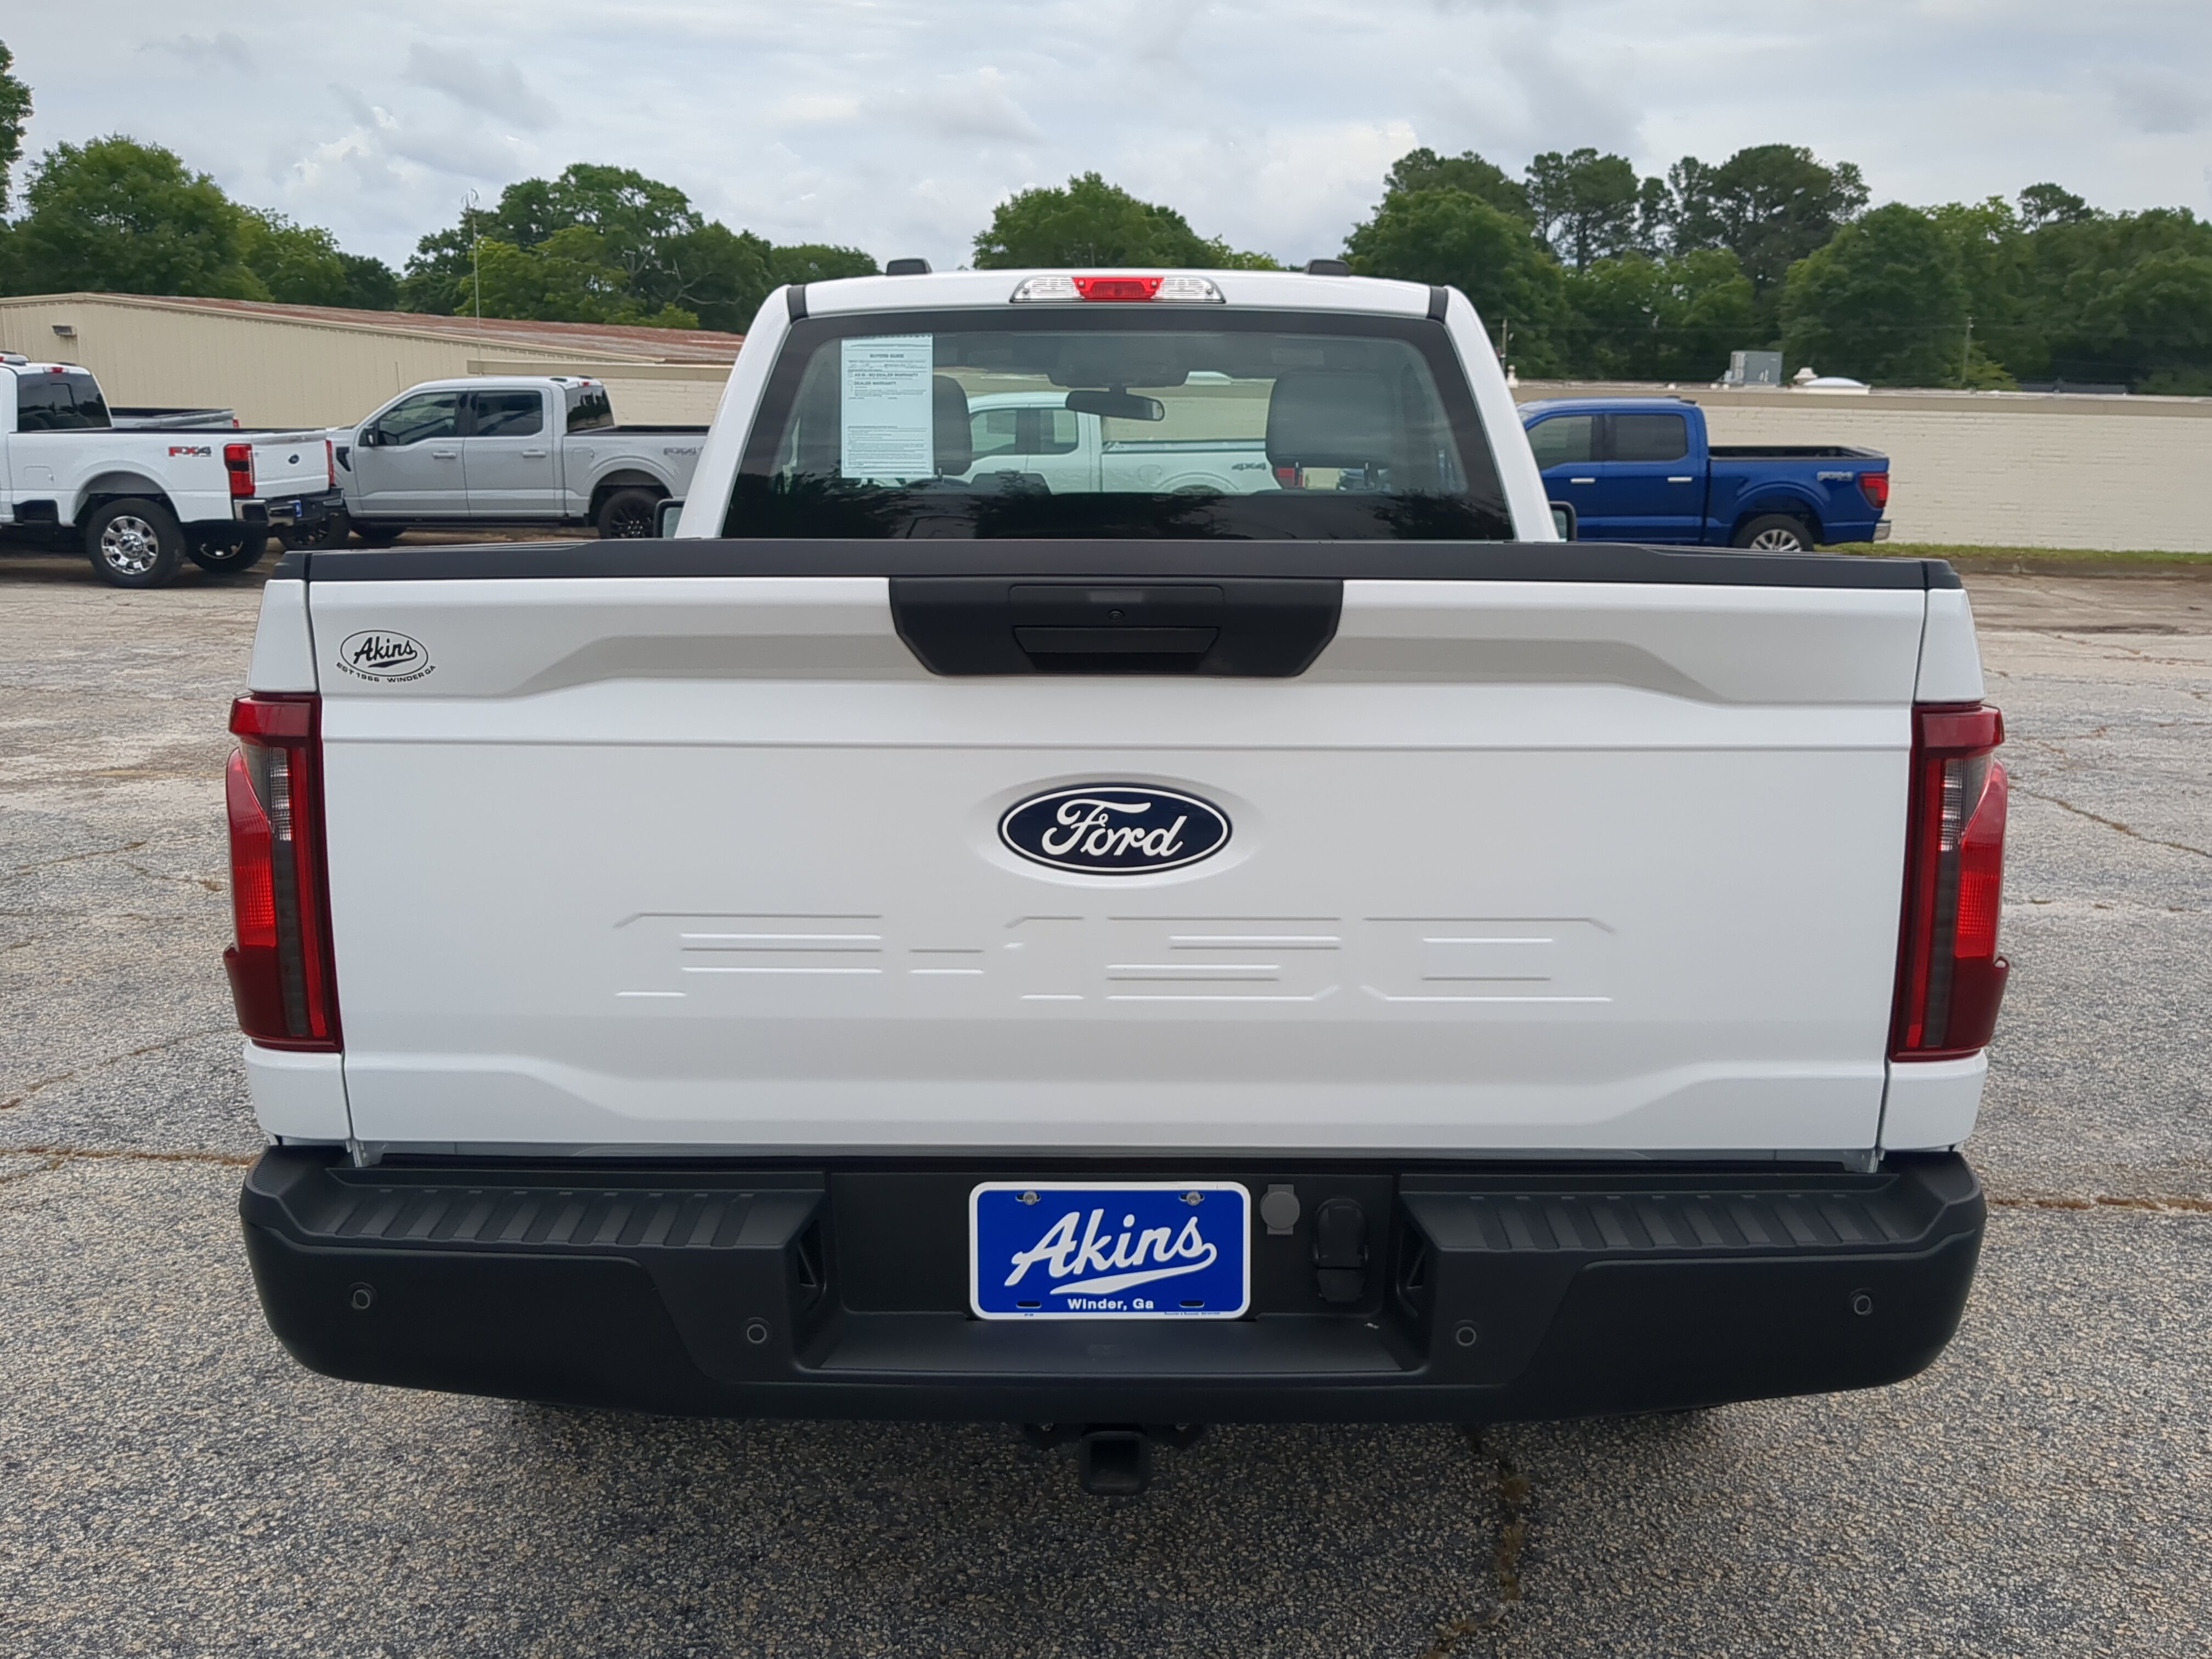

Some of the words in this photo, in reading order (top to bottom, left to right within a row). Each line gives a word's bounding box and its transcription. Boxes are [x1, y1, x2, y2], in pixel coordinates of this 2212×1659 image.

[168, 446, 212, 457] FX4
[353, 636, 417, 668] Akins
[336, 662, 354, 675] EST
[356, 673, 380, 682] 1966
[387, 672, 425, 683] WINDER
[425, 665, 437, 675] GA
[1041, 798, 1188, 857] Ford
[1003, 1207, 1217, 1294] Akins
[1067, 1298, 1127, 1311] Winder,
[1132, 1298, 1154, 1310] Ga
